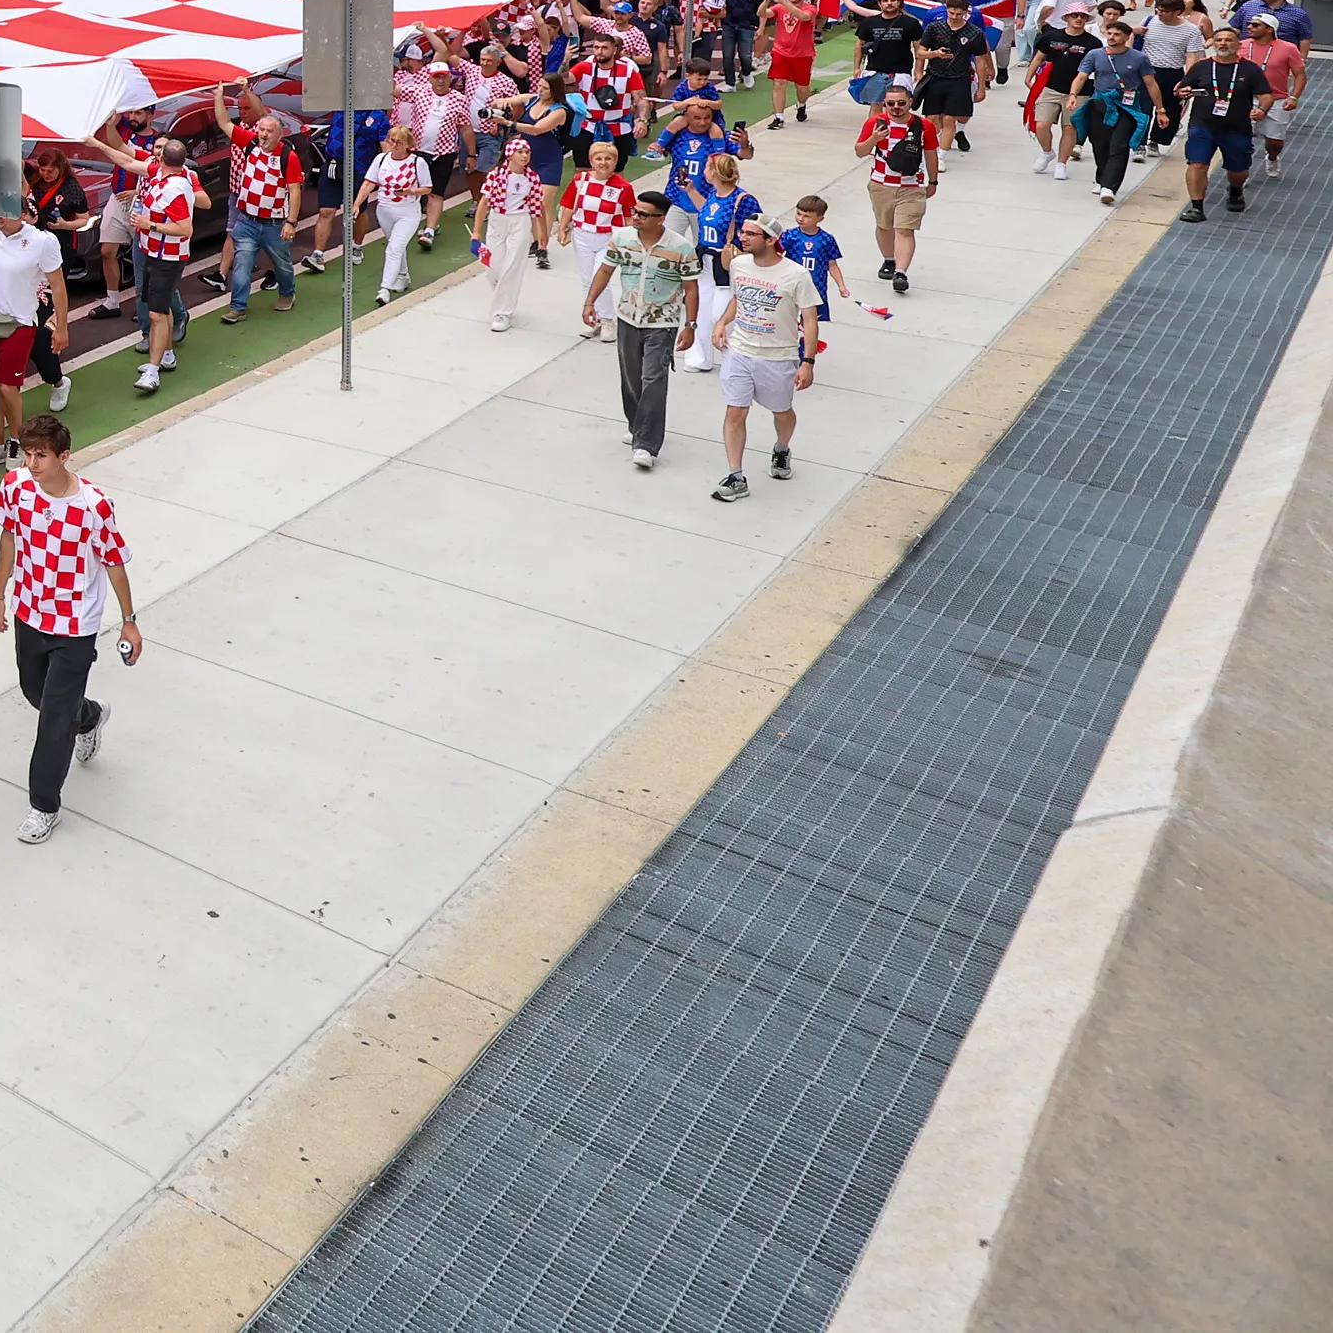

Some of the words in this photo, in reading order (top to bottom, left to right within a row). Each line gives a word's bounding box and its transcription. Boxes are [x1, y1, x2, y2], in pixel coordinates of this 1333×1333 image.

[703, 225, 718, 244] 10
[801, 256, 816, 272] 10
[751, 278, 779, 291] COLLEGE
